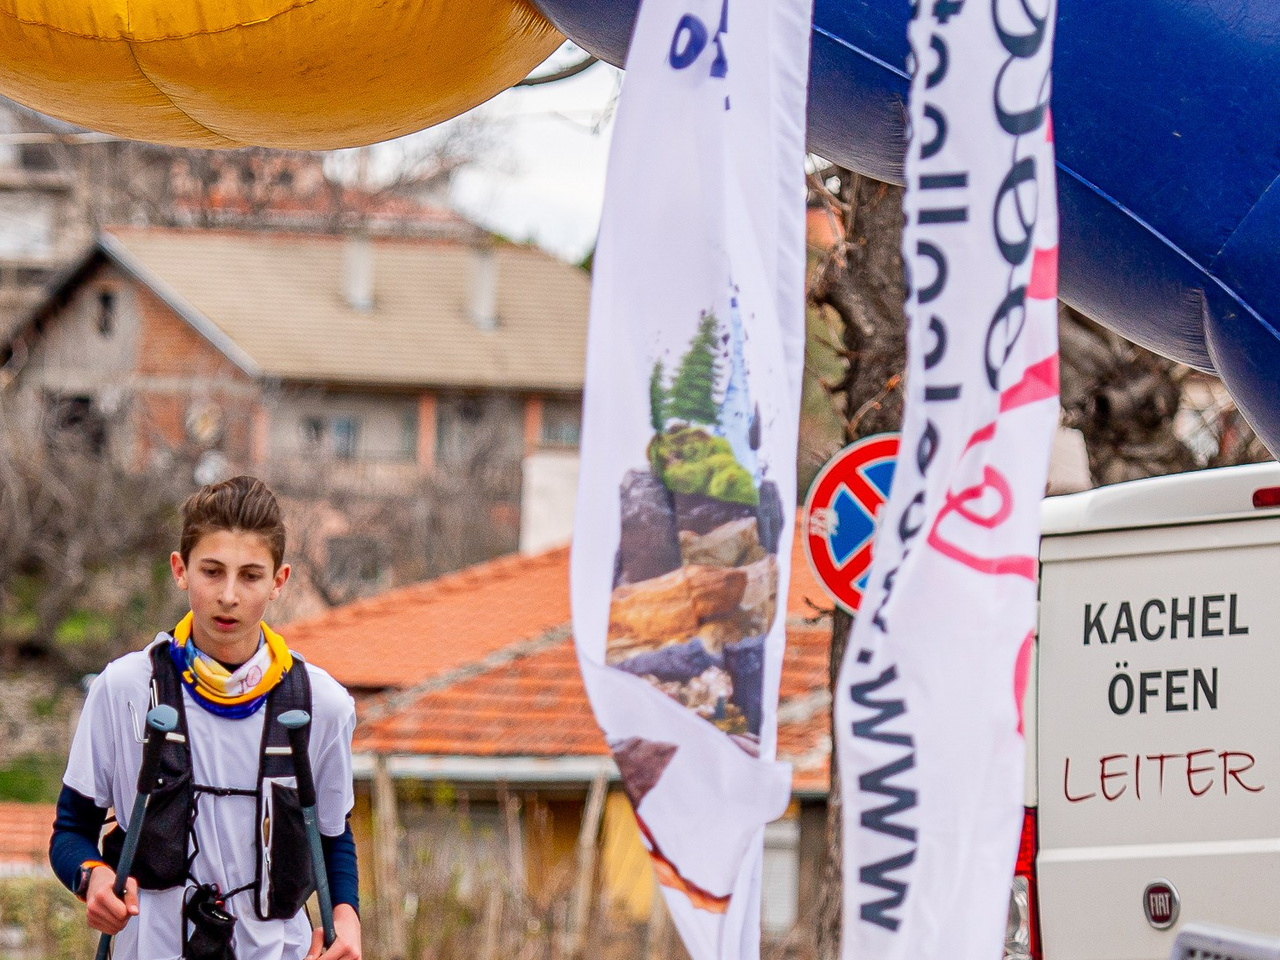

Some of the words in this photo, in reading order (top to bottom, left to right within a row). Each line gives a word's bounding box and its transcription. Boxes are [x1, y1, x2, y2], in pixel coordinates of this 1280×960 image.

[1083, 593, 1249, 646] KACHEL
[1108, 661, 1218, 716] ÖFEN
[1064, 749, 1266, 802] LEITER
[1149, 892, 1171, 917] FIAT
